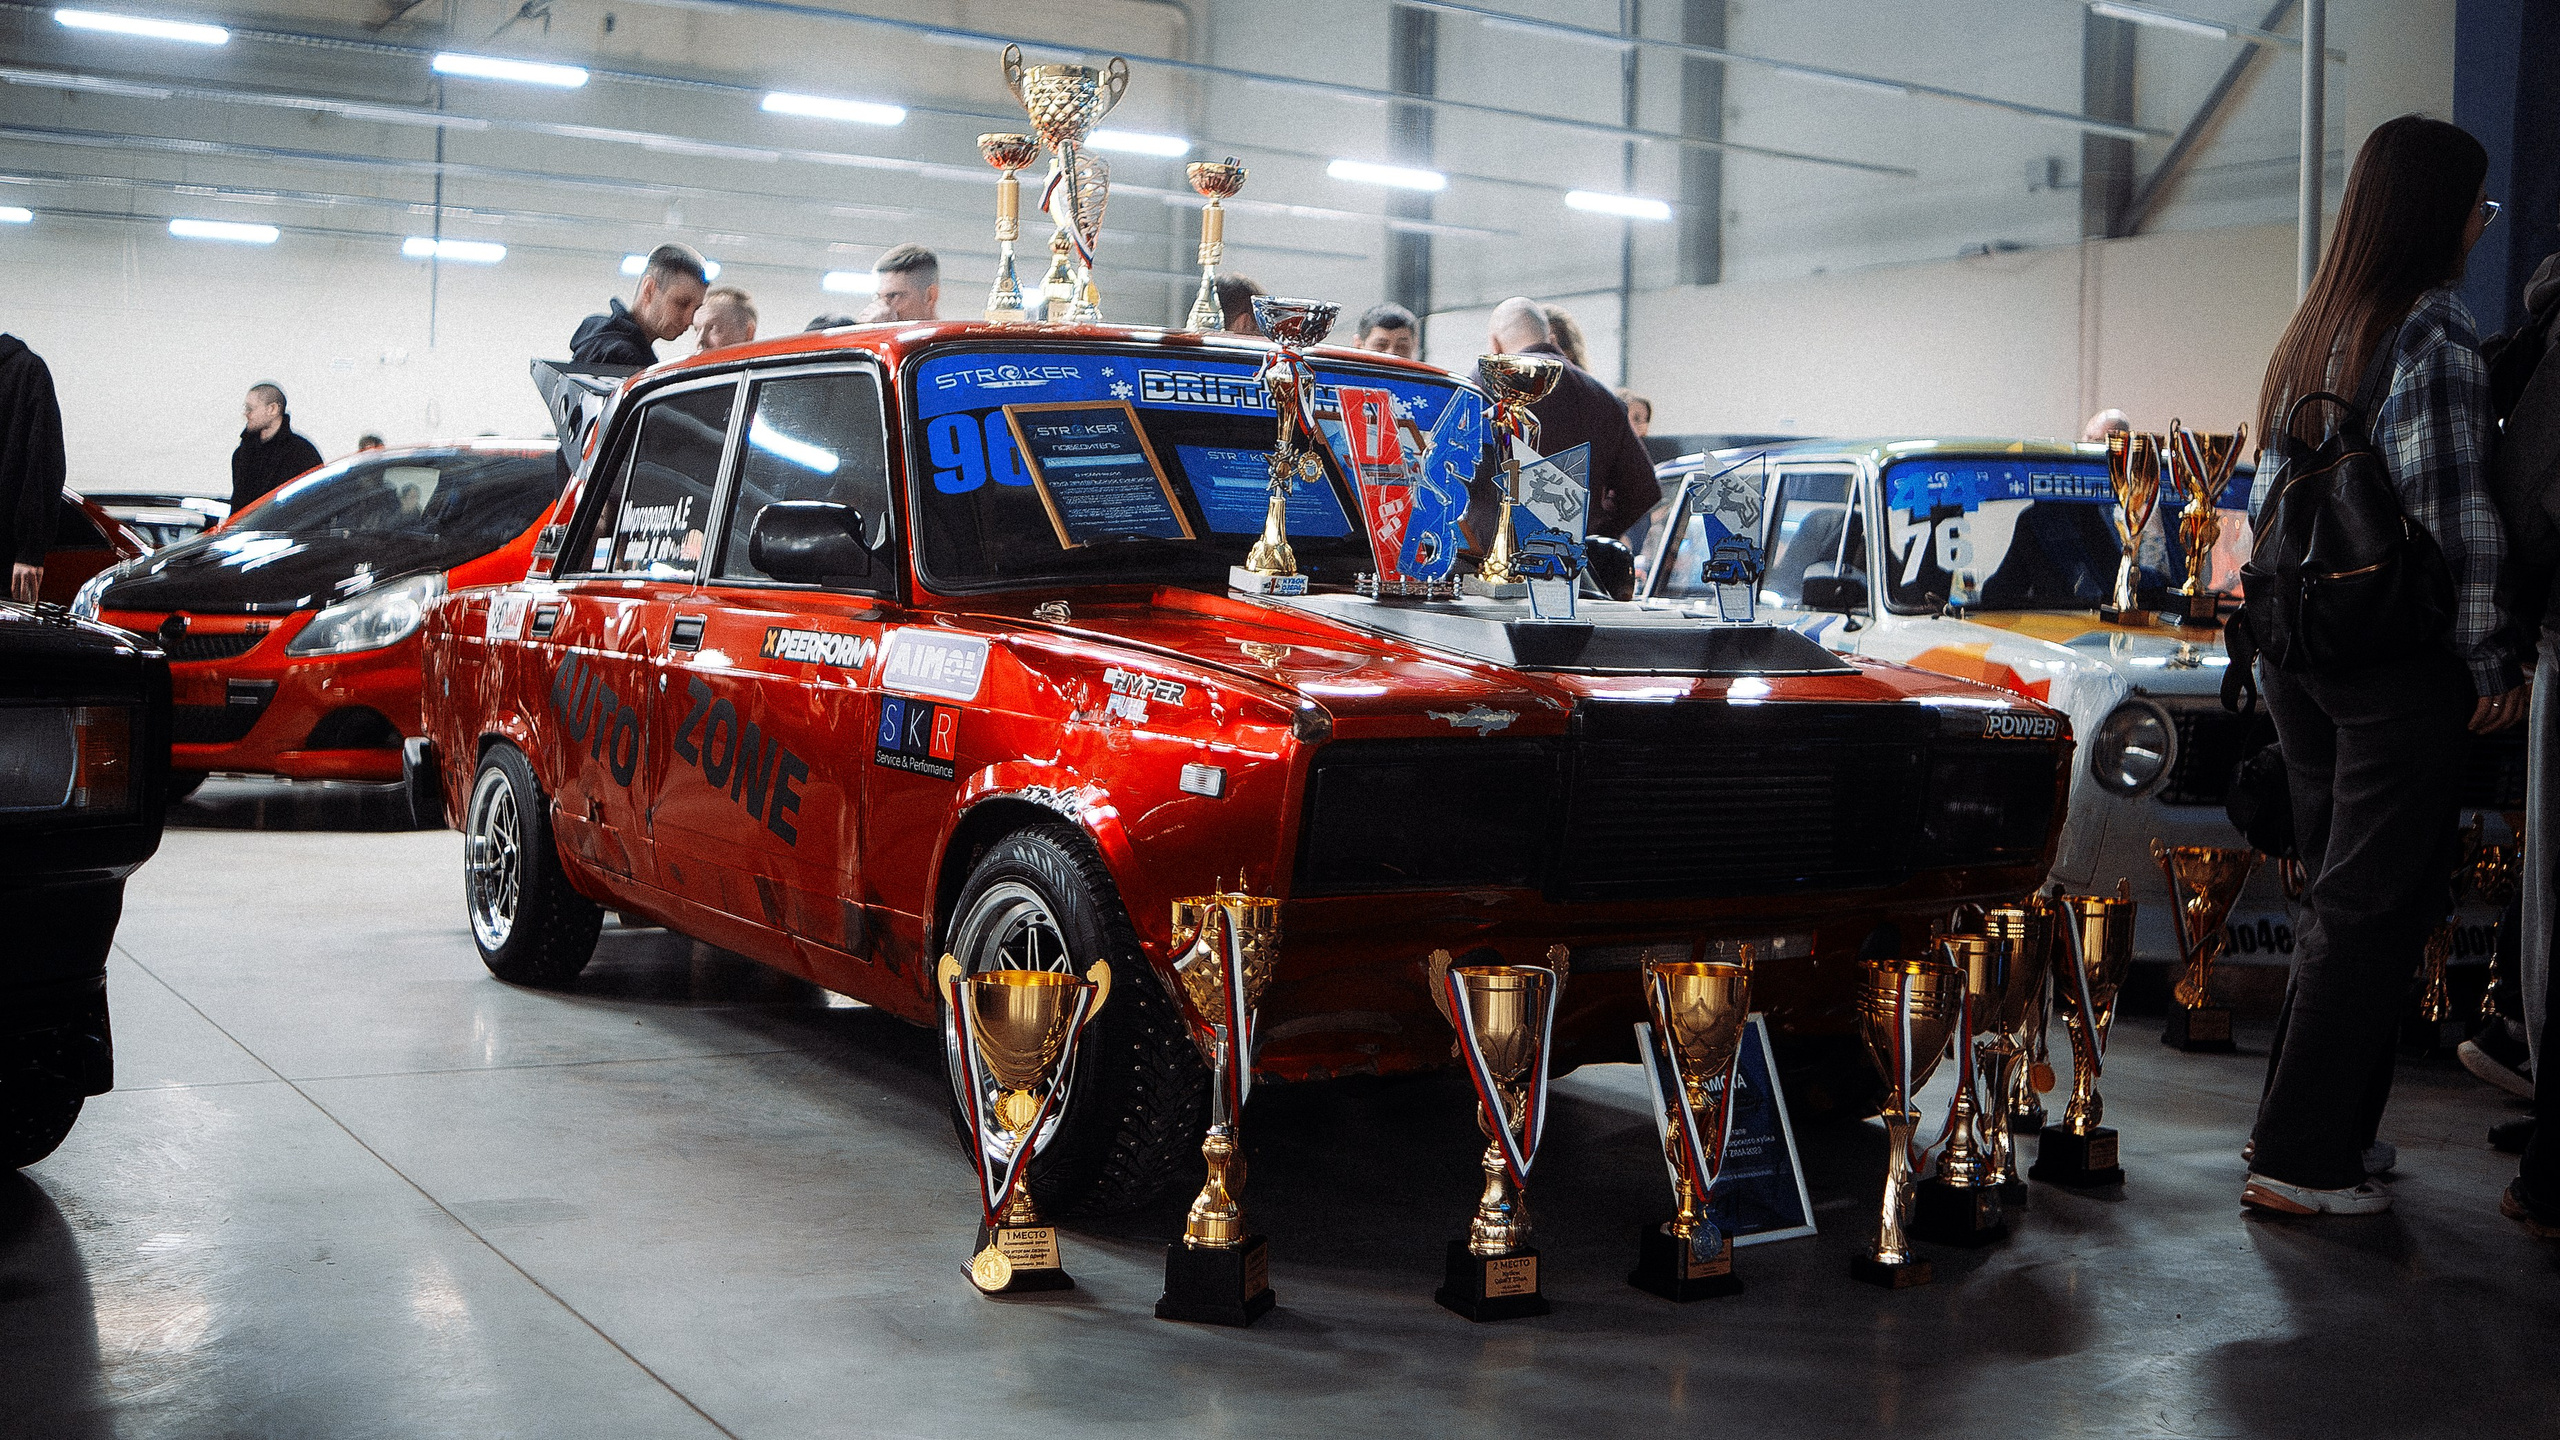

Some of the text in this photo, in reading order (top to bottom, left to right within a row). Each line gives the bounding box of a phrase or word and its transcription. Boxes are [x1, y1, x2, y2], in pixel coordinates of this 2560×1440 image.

[935, 365, 1082, 390] STROKER
[1141, 371, 1263, 408] DRIFT
[1037, 424, 1119, 437] STROKER
[926, 410, 1036, 495] 96
[1113, 671, 1186, 706] HYPER
[550, 651, 640, 788] AUTO
[883, 703, 952, 754] SKR
[1987, 714, 2057, 736] POWER
[673, 674, 810, 848] ZONE
[876, 750, 902, 767] Service
[902, 755, 909, 768] &
[1012, 1230, 1047, 1240] МЕСТО
